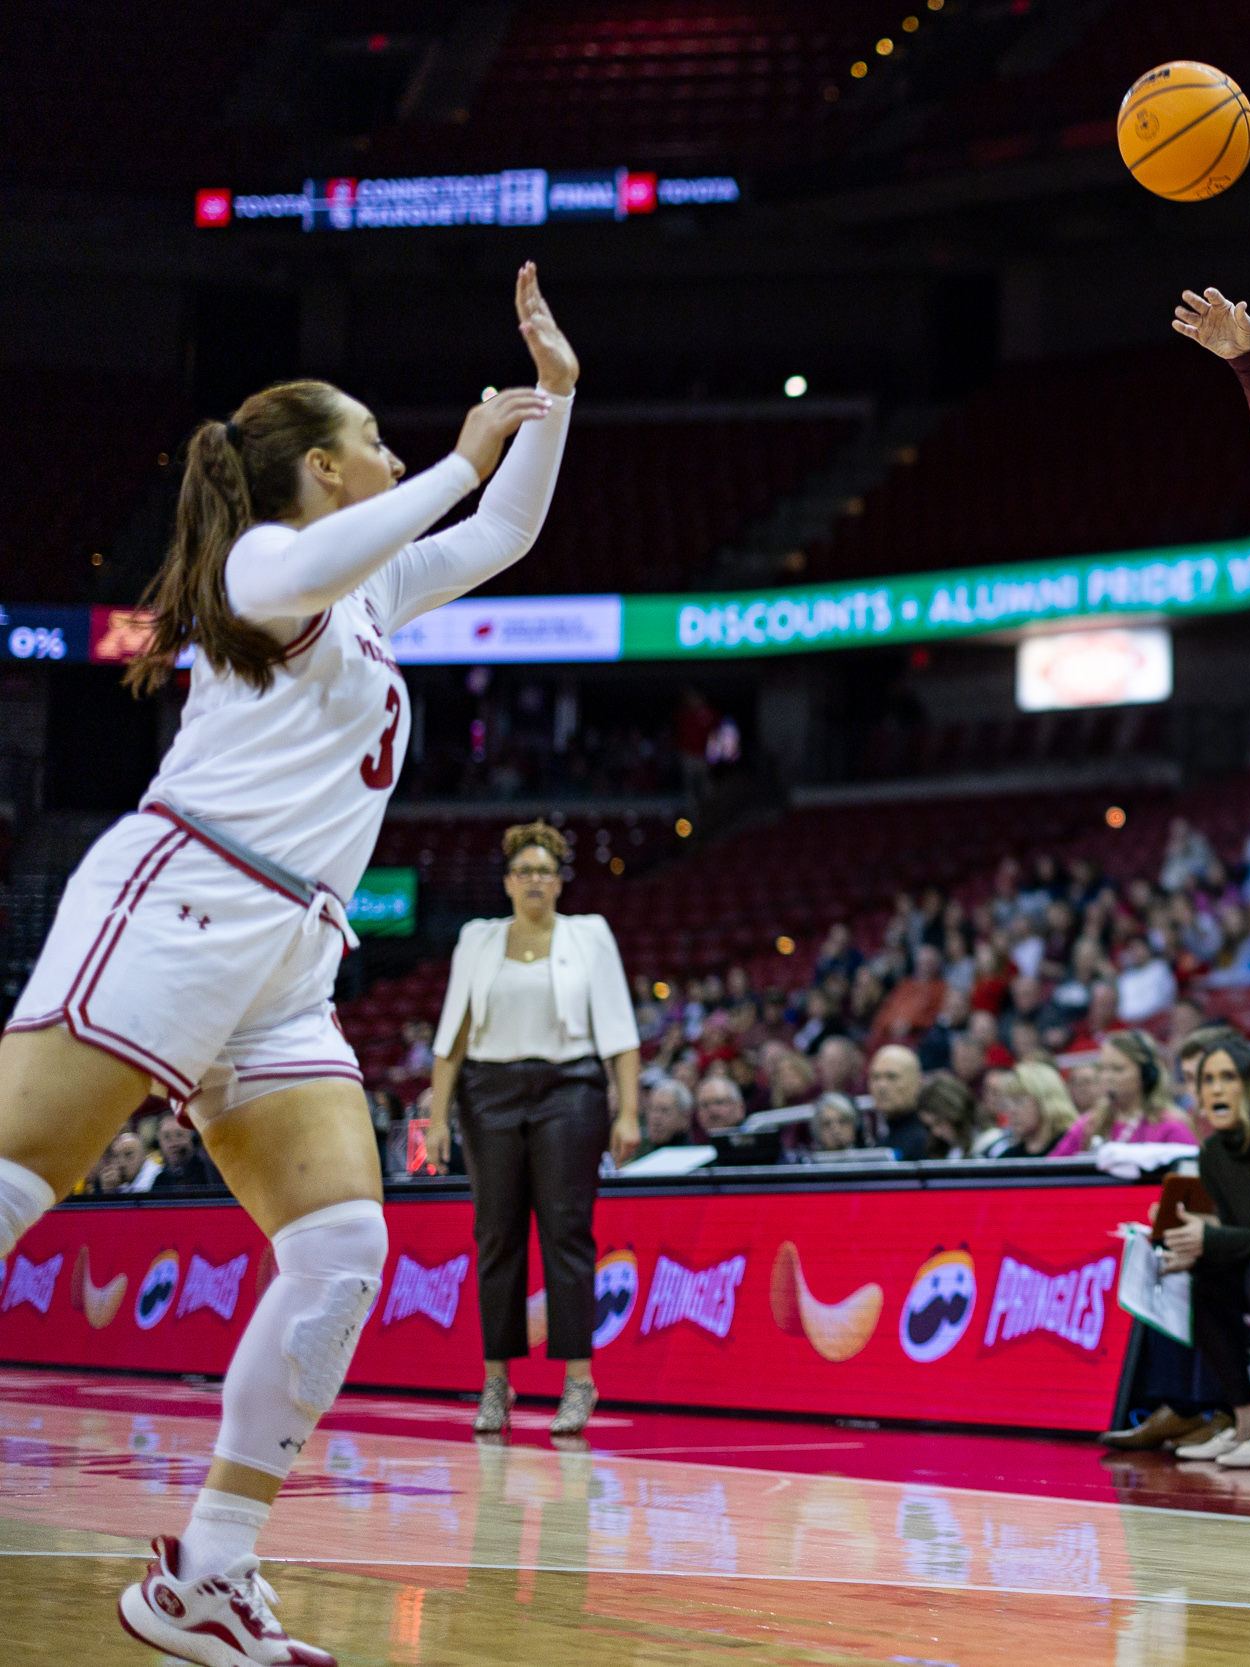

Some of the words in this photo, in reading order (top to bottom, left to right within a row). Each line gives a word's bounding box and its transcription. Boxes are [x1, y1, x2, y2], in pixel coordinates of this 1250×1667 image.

[8, 626, 67, 660] 0%
[679, 589, 893, 647] DISCOUNTS
[928, 573, 1079, 625] ALUMNI
[1087, 556, 1218, 606] PRIDE?
[360, 684, 401, 790] 3
[983, 1255, 1117, 1351] PRINGLES
